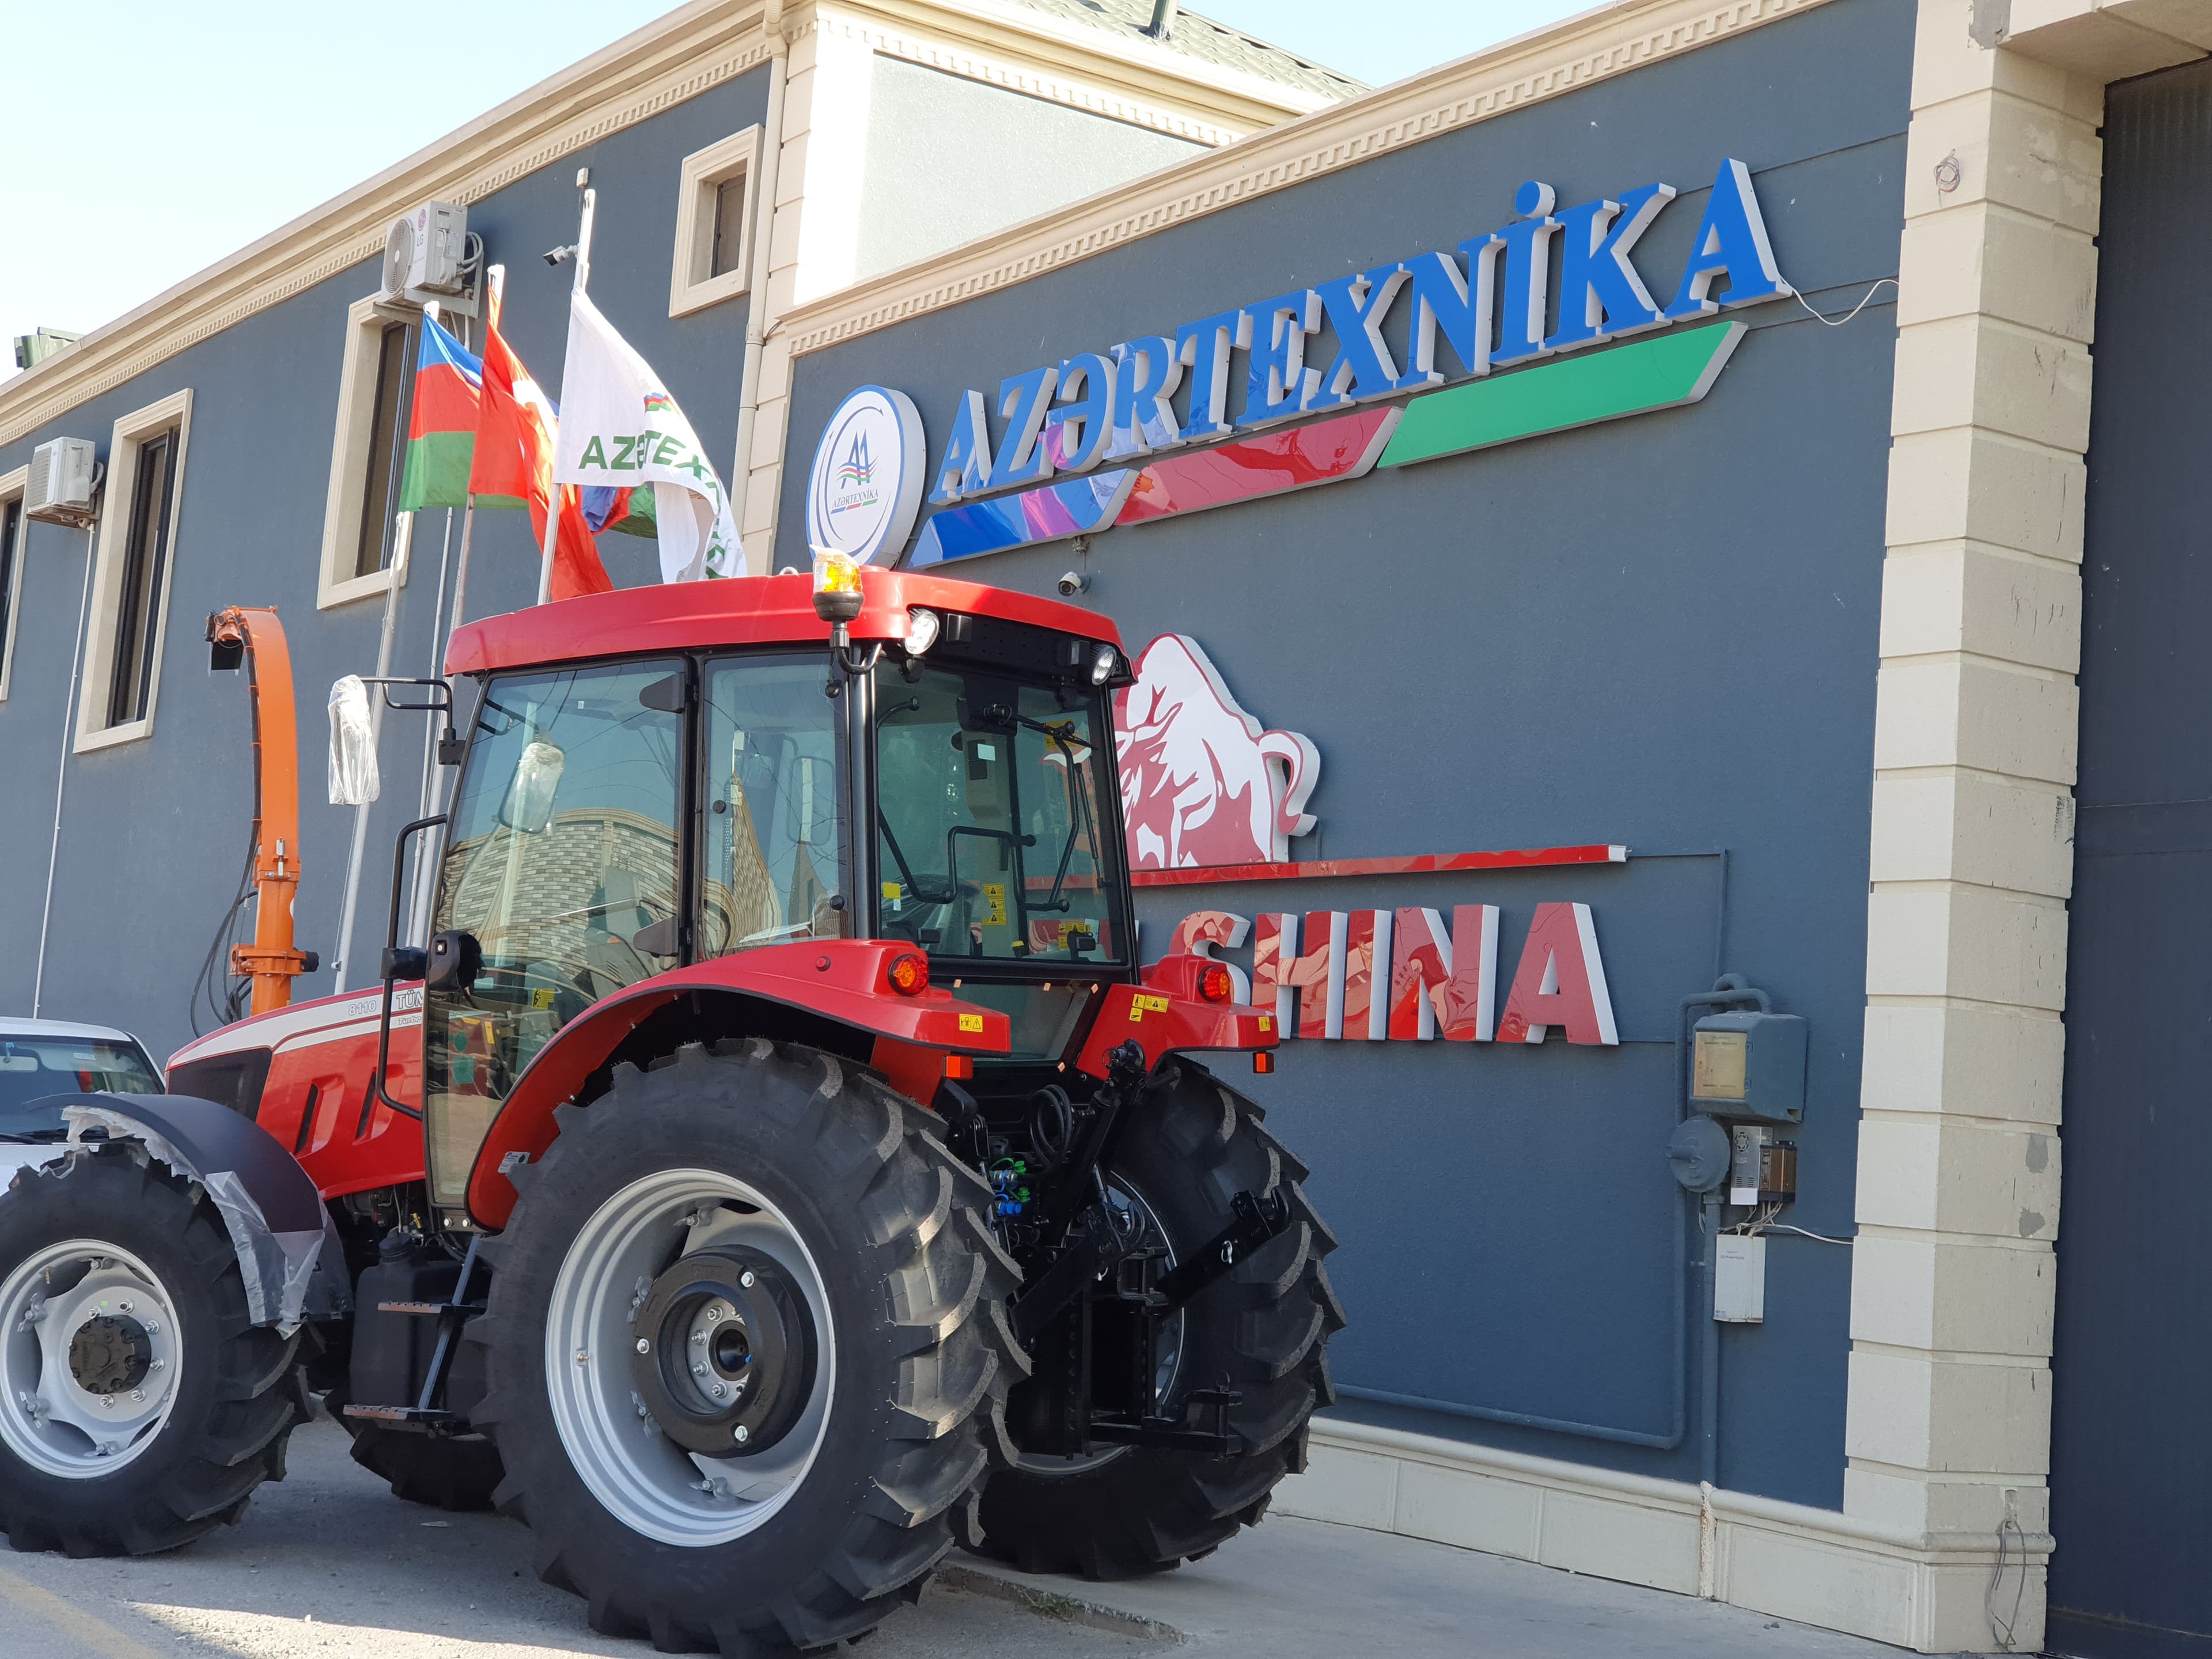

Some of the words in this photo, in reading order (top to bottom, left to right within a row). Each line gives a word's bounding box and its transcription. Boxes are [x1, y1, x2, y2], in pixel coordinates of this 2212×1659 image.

[416, 234, 424, 247] LG
[927, 158, 1792, 505] AZƏRTEXNİKA
[832, 487, 878, 509] AZƏRTEXNİKA
[348, 999, 377, 1016] 8110
[397, 1015, 422, 1025] Turbo
